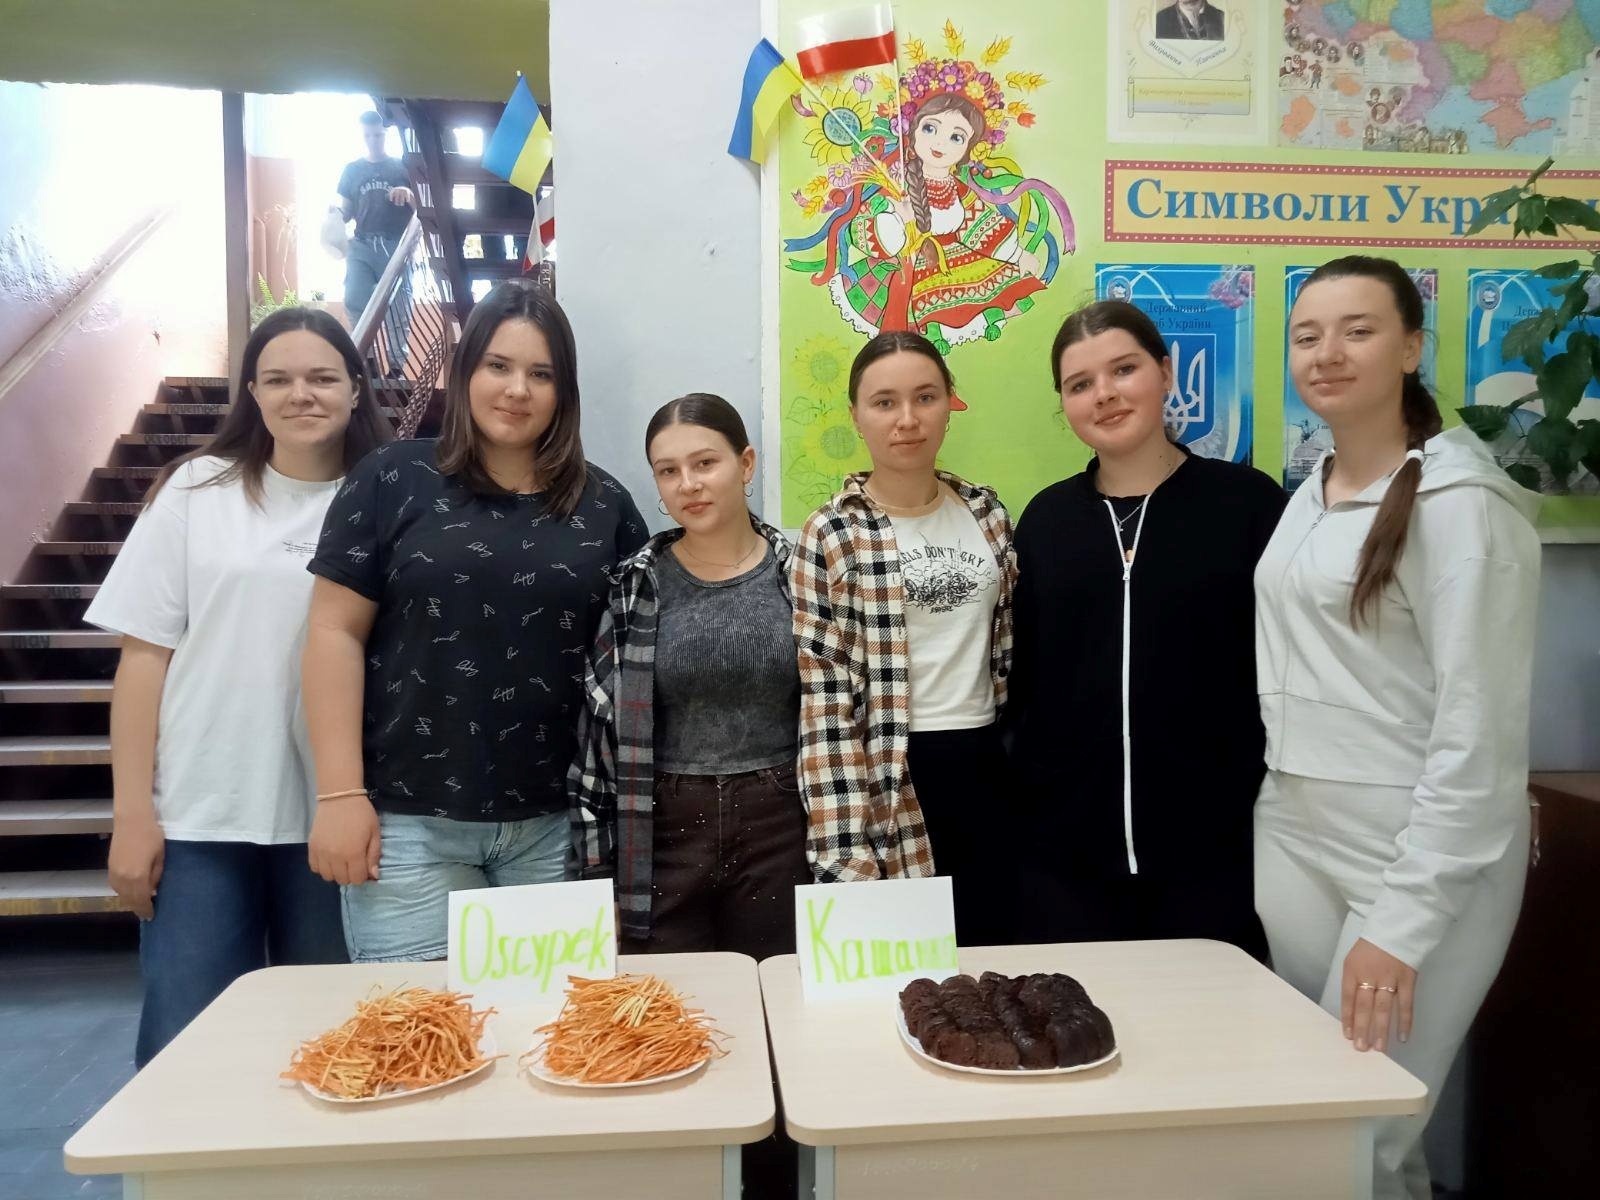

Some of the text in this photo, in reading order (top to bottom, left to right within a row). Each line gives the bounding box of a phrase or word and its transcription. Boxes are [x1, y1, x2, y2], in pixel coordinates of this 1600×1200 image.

[1126, 177, 1370, 222] Символи
[1168, 316, 1211, 331] України
[924, 545, 955, 559] DON'T
[960, 551, 986, 568] CRY
[459, 902, 612, 993] Oscypek
